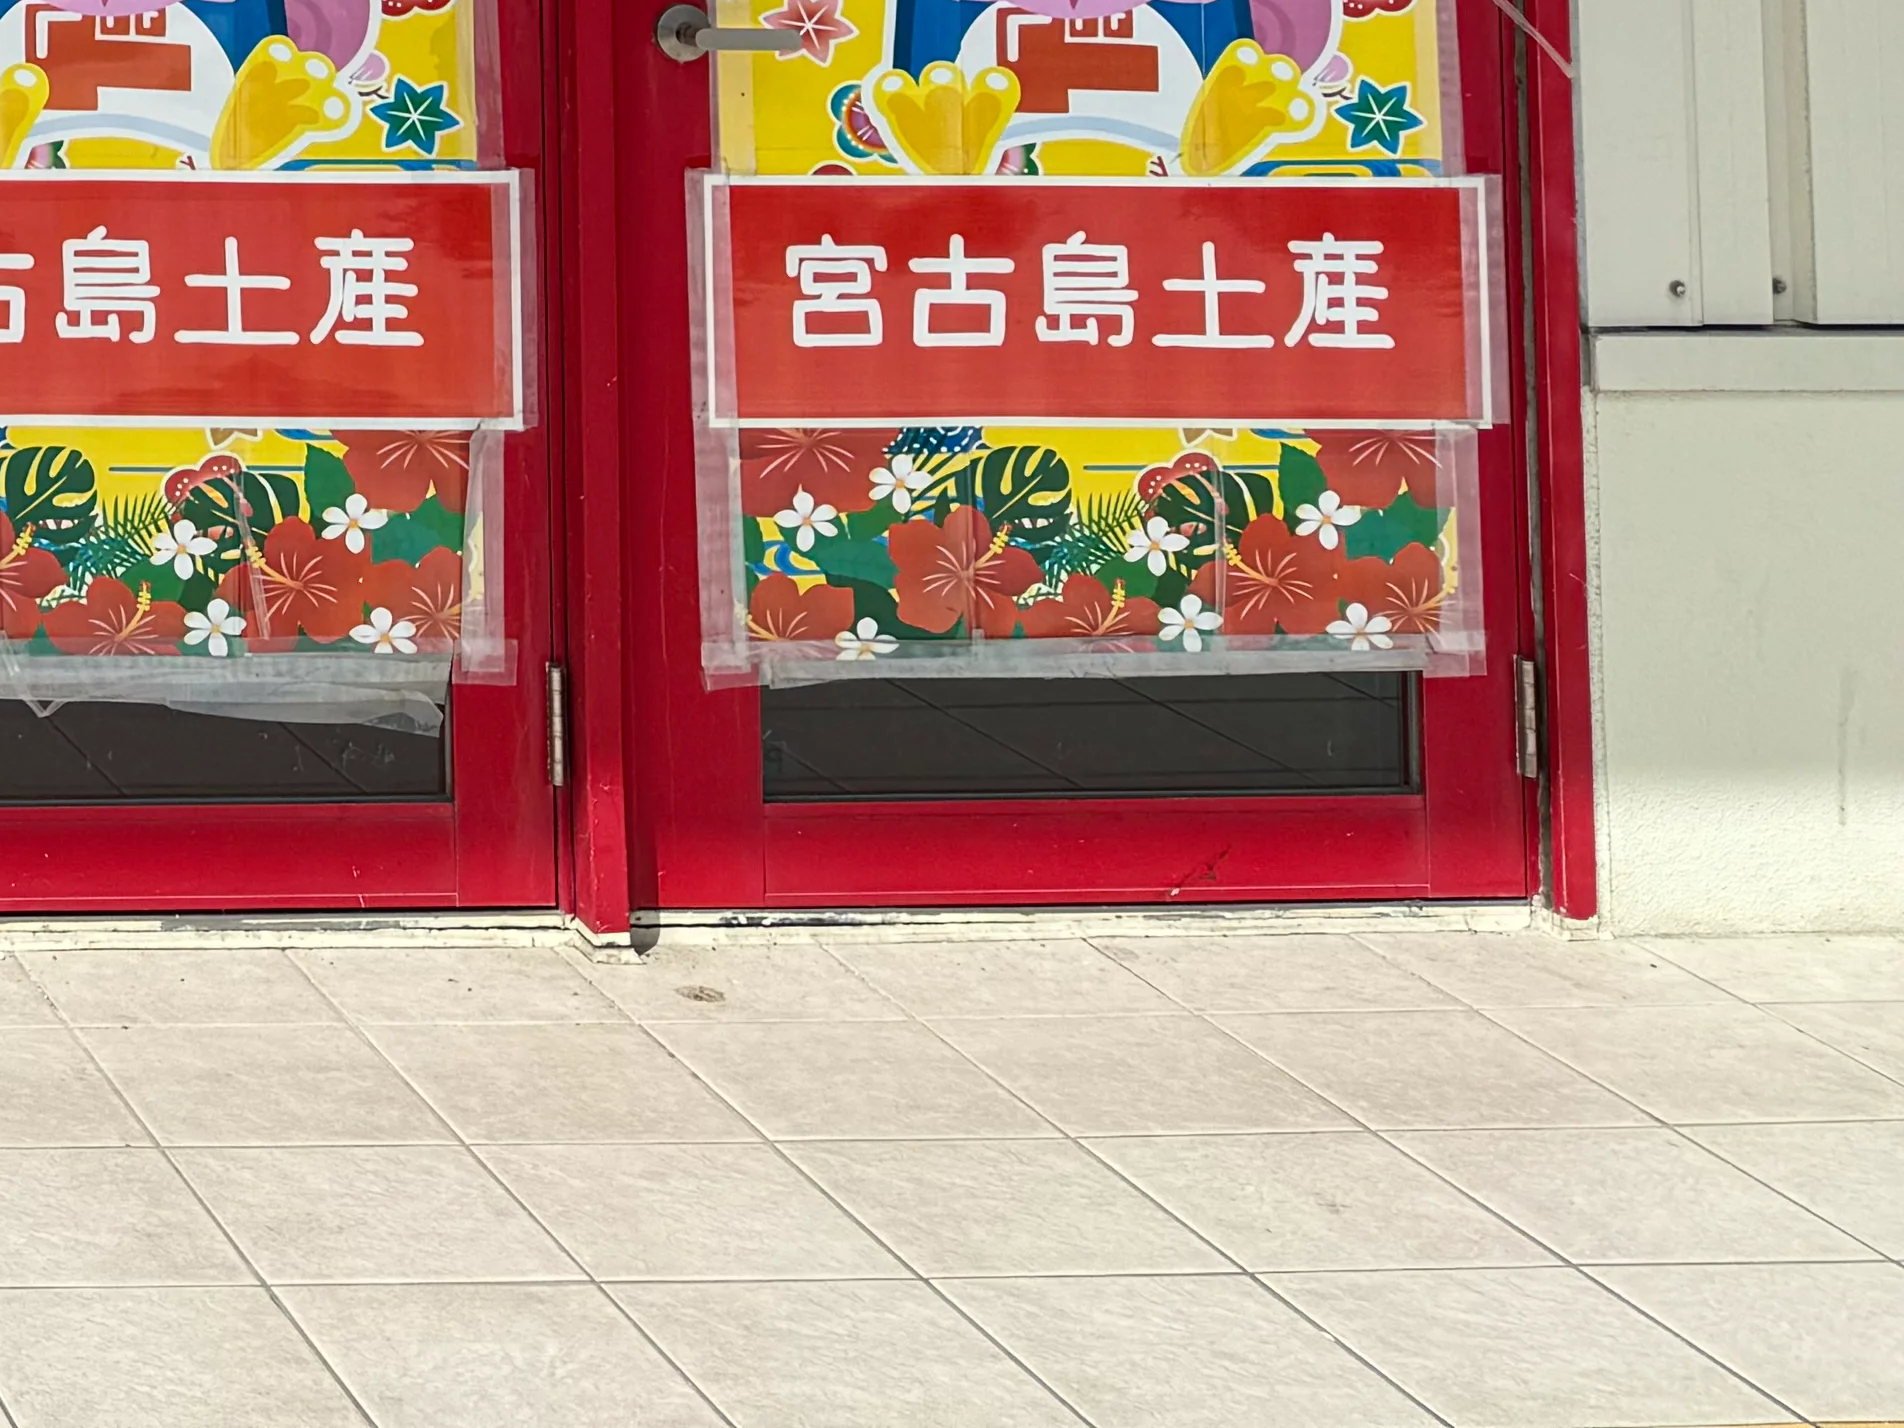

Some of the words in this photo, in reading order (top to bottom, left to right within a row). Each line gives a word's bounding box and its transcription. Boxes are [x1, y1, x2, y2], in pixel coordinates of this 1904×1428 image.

[785, 230, 1395, 349] 宮古島土産
